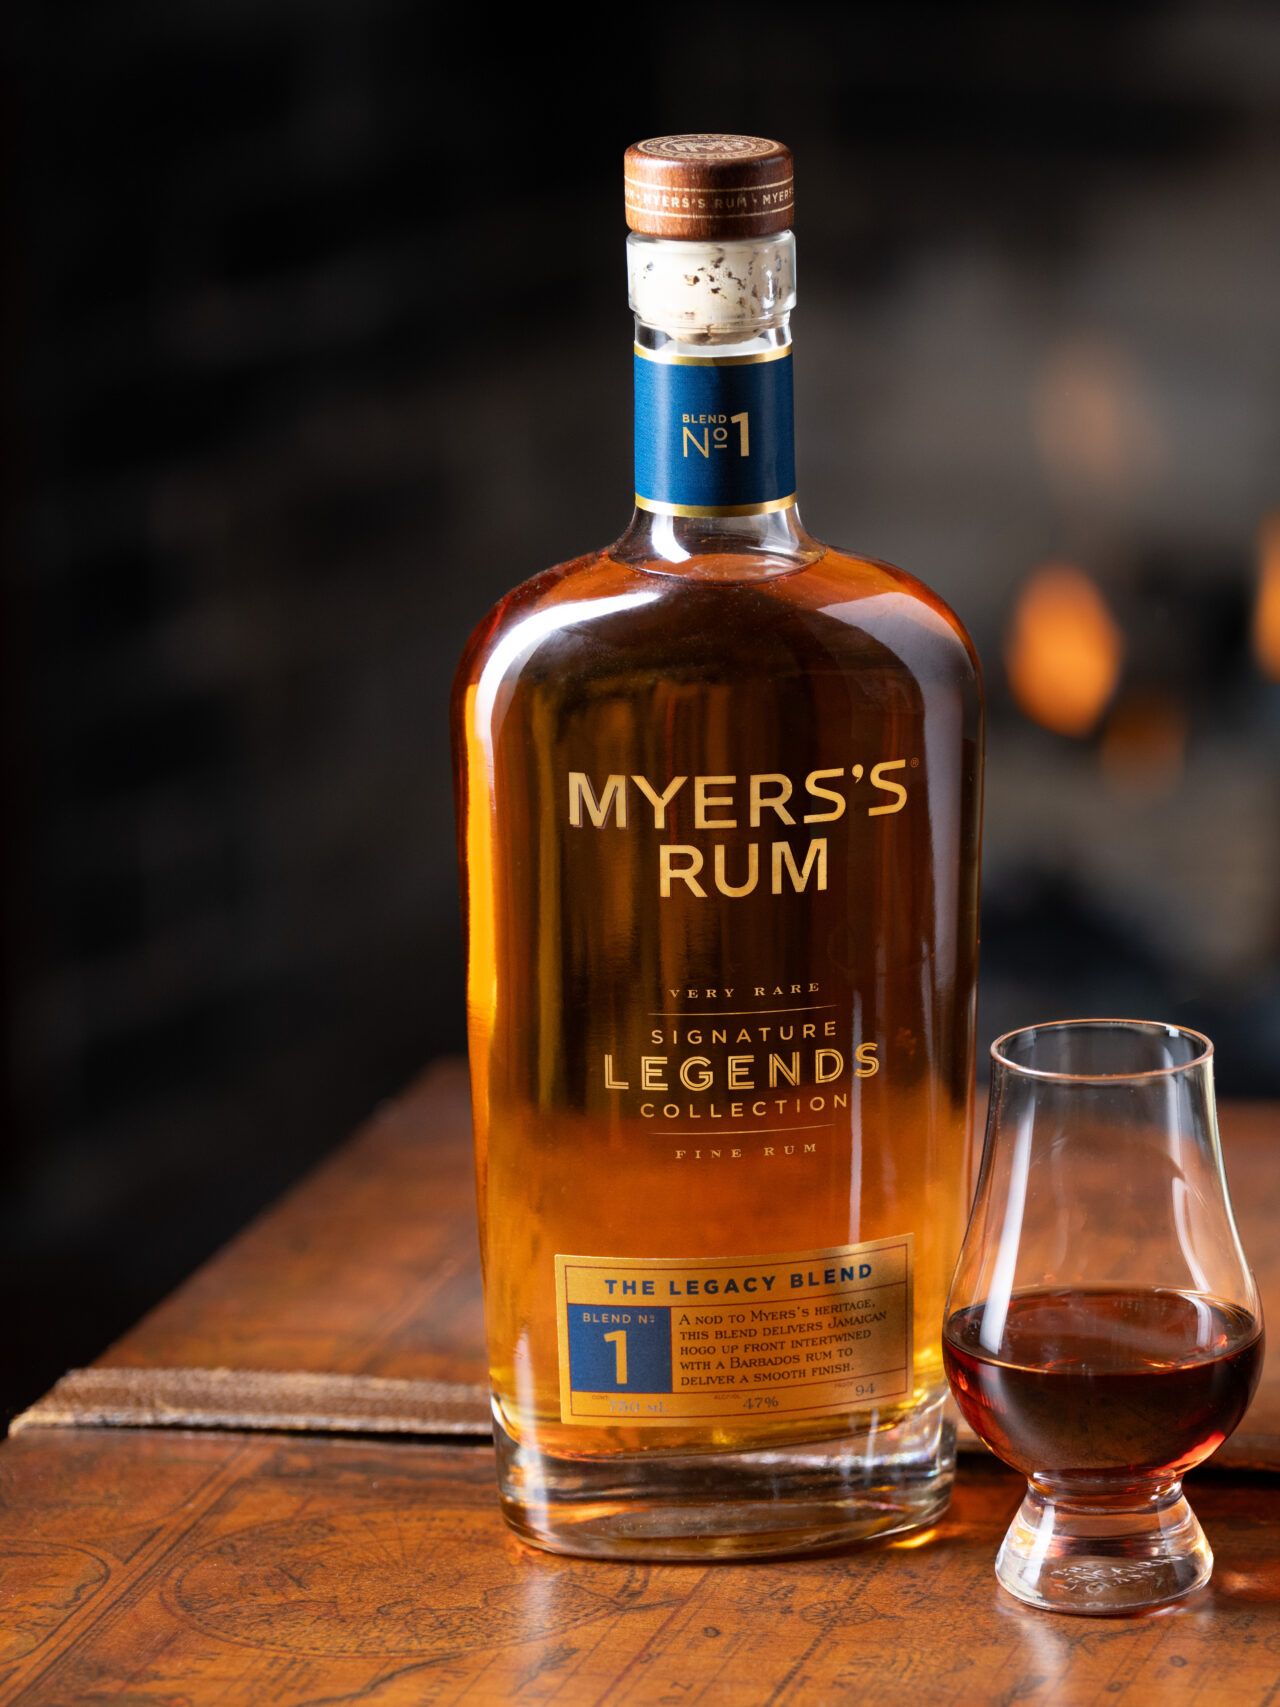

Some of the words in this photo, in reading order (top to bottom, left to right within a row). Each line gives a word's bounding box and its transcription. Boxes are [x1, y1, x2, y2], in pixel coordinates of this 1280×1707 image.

[643, 193, 706, 208] MYERS'S
[714, 196, 747, 208] RUM
[682, 414, 727, 423] BLEND
[731, 412, 750, 457] 1
[568, 759, 908, 830] MYERS'S
[659, 837, 828, 898] RUM
[669, 988, 735, 999] VERY
[754, 982, 821, 997] RARE
[651, 1021, 837, 1044] SIGNATURE
[604, 1042, 880, 1091] LEGENDS
[640, 1093, 848, 1118] COLLECTION
[675, 1148, 743, 1160] FINE
[764, 1144, 817, 1156] RUM
[604, 1279, 655, 1296] THE
[669, 1275, 776, 1295] LEGACY
[790, 1263, 872, 1289] BLEND
[583, 1312, 632, 1324] BLEND
[679, 1314, 690, 1325] A
[695, 1315, 723, 1324] NOD
[728, 1314, 745, 1324] TO
[680, 1330, 709, 1340] THIS
[715, 1328, 757, 1339] BLEND
[762, 1322, 823, 1337] DELIVERS
[680, 1346, 716, 1355] HOGO
[722, 1344, 739, 1354] UP
[744, 1341, 785, 1352] FRONT
[791, 1329, 871, 1348] INTERTWINED
[603, 1330, 628, 1385] 1
[680, 1361, 711, 1370] WITH
[715, 1361, 725, 1369] A
[806, 1351, 832, 1362] RUM
[837, 1347, 853, 1358] TO
[681, 1375, 735, 1386] DELIVER
[739, 1375, 749, 1383] A
[753, 1368, 806, 1382] SMOOTH
[856, 1382, 874, 1396] 94
[608, 1400, 640, 1413] 750
[743, 1397, 778, 1409] 47%
